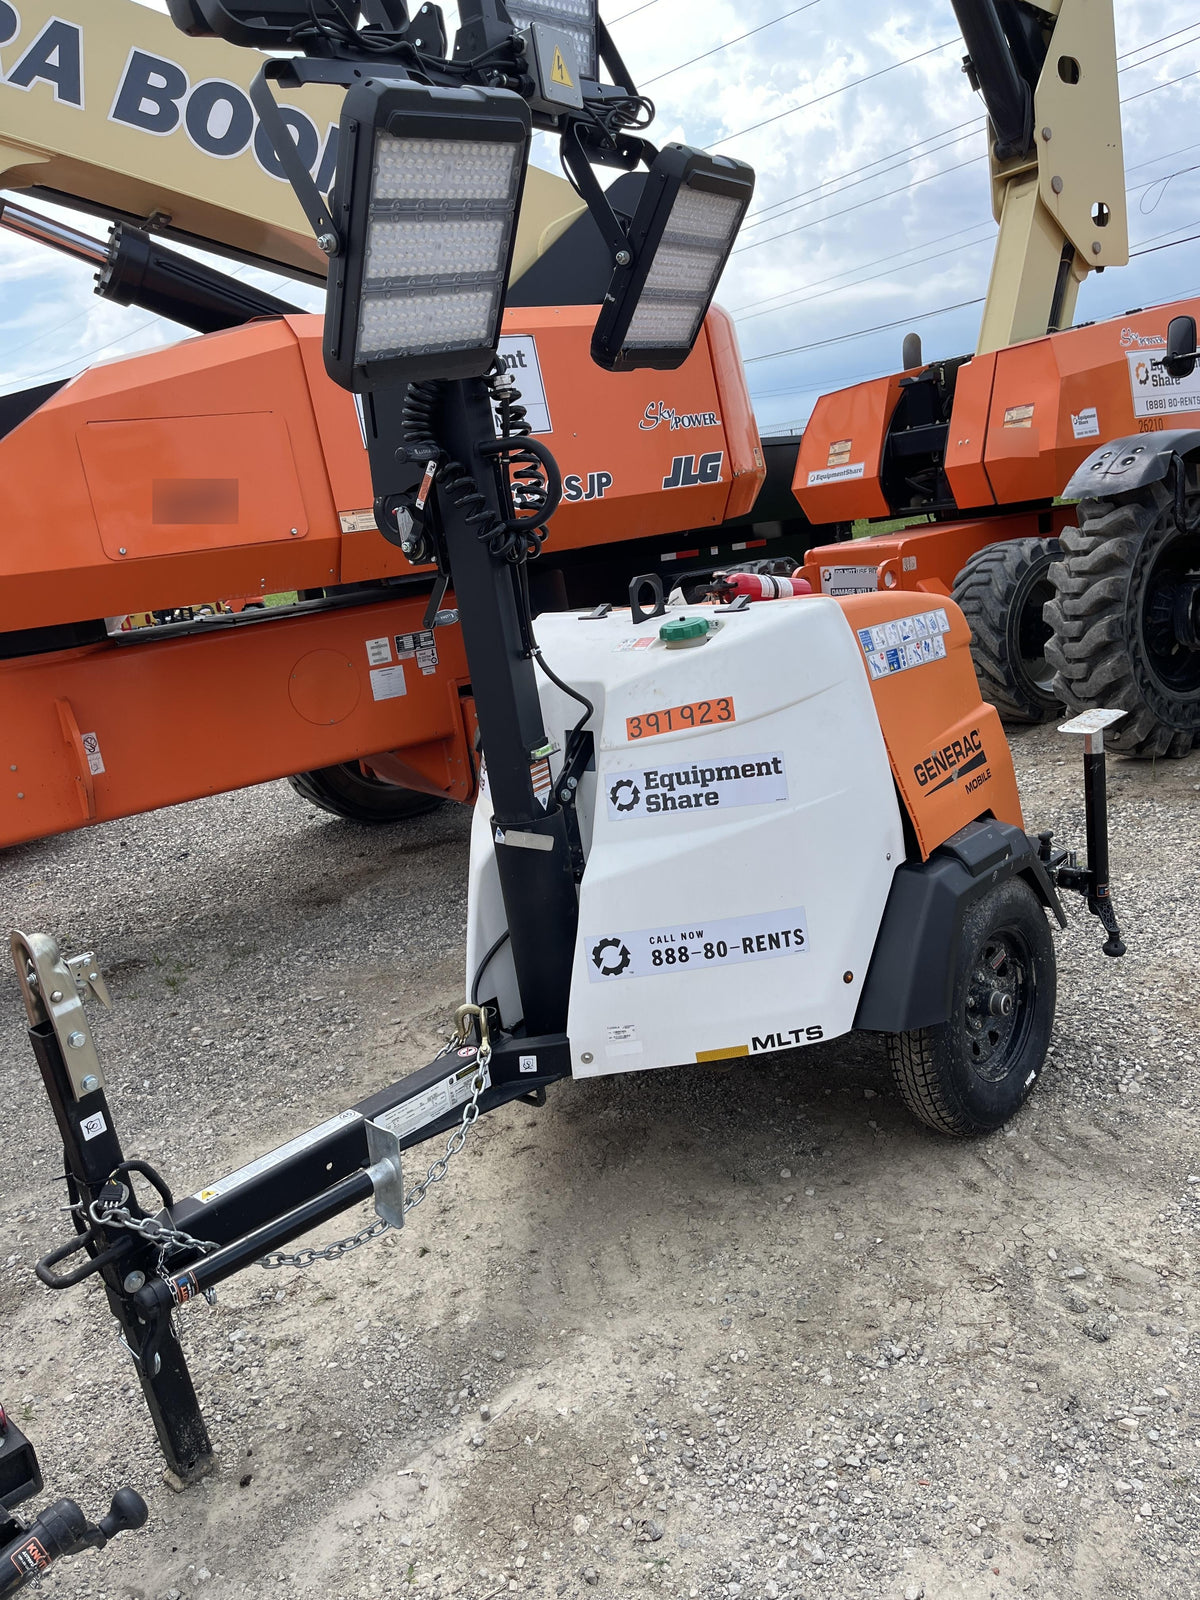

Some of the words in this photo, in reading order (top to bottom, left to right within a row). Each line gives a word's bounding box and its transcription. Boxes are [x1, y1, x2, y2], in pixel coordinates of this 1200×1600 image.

[662, 451, 723, 490] JLG
[629, 698, 732, 738] 391923
[643, 757, 783, 791] Equipment
[913, 729, 982, 787] GENERAC
[964, 768, 992, 795] MOBILE
[645, 790, 720, 813] Share
[649, 934, 676, 945] CALL
[680, 930, 704, 941] NOW
[651, 928, 805, 967] 888-80-RENTS
[751, 1025, 824, 1051] MLTS
